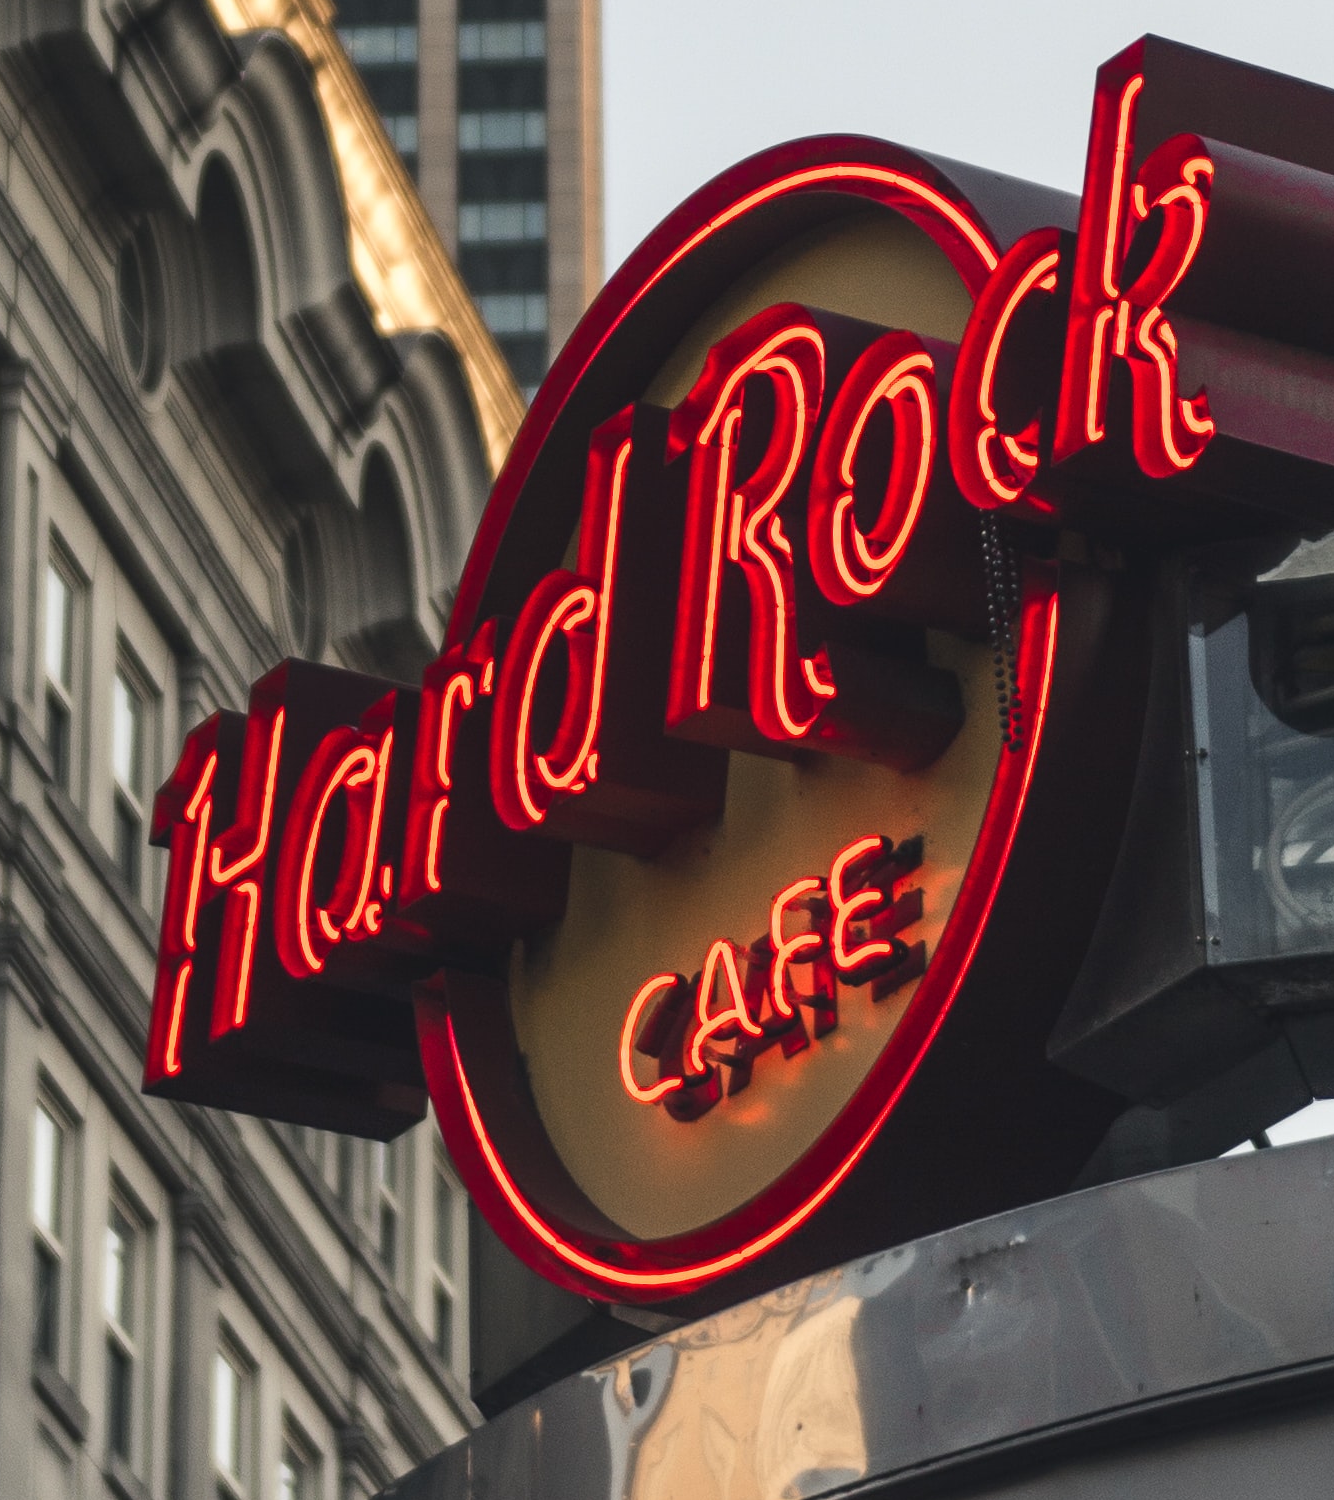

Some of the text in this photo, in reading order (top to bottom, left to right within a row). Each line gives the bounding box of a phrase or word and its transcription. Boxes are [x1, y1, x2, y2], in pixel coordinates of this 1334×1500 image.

[147, 34, 1215, 1086] Hard Rock
[620, 834, 905, 1108] CAFE
